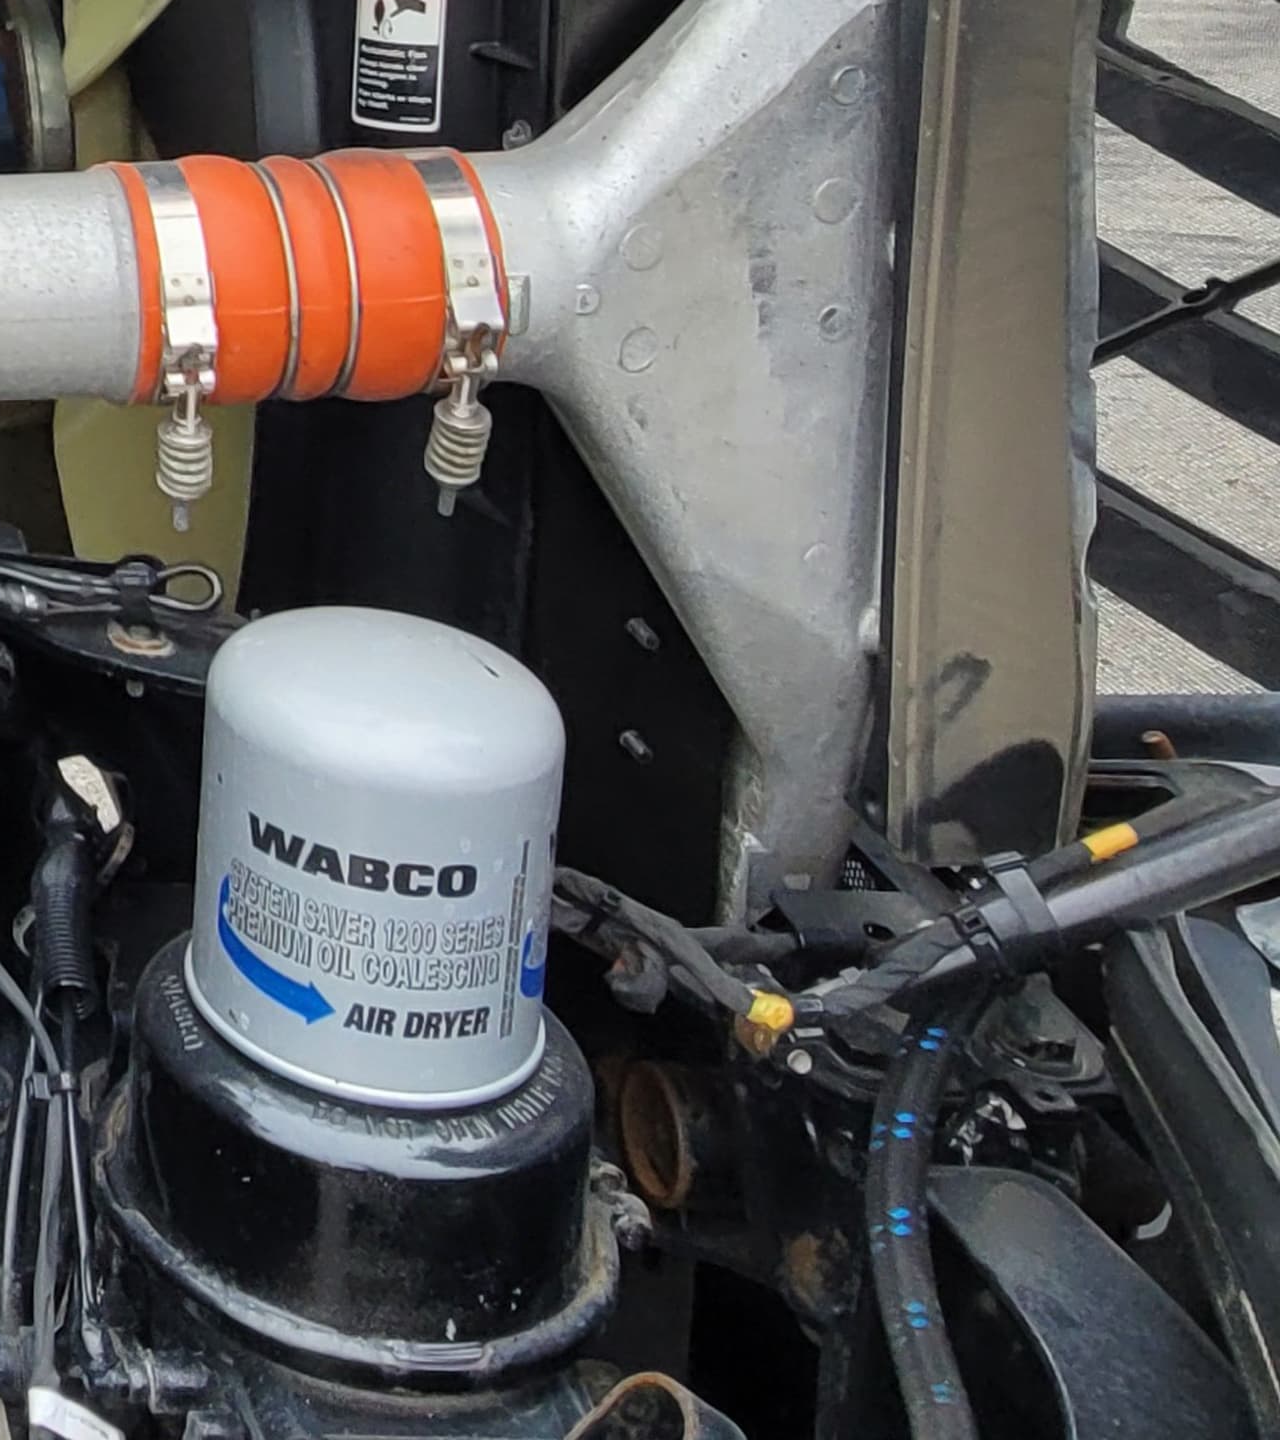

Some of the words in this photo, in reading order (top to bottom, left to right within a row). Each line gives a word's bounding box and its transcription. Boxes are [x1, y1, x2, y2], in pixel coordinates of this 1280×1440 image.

[248, 811, 477, 898] WABCO
[226, 895, 312, 969] PREMIUM
[319, 943, 355, 981] OIL
[360, 953, 500, 991] COALESCING
[229, 858, 301, 928] SYSTEM
[302, 899, 376, 949] SAVER
[383, 918, 437, 955] 1200
[440, 914, 505, 955] SERIES
[344, 1002, 397, 1038] AIR
[403, 1006, 491, 1040] DRYER
